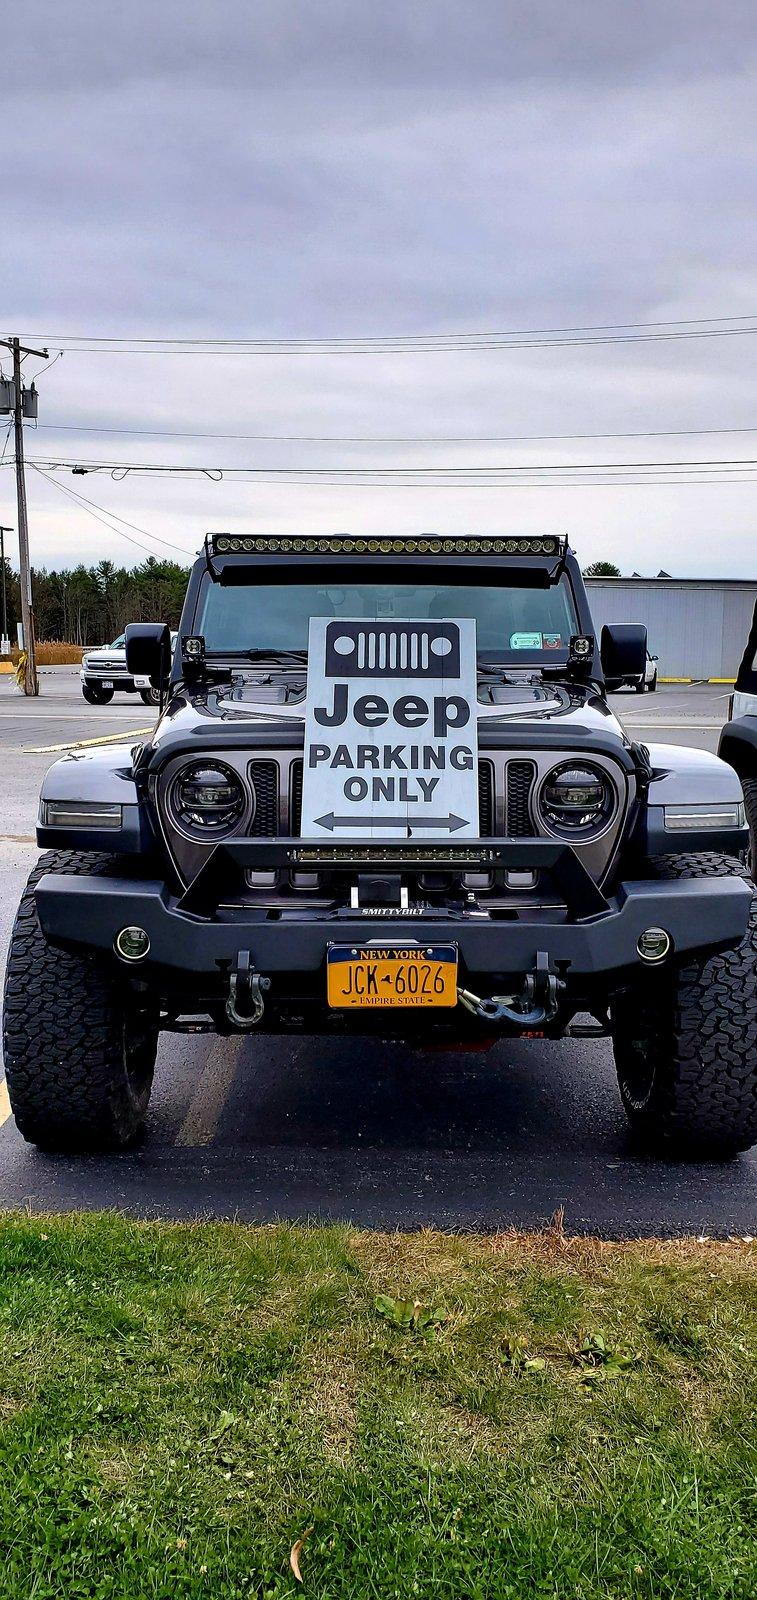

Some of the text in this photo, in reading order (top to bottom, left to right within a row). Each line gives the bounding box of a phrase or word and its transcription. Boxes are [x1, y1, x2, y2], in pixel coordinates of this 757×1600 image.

[313, 683, 471, 738] Jeep
[308, 744, 474, 771] PARKING
[343, 776, 440, 803] ONLY
[359, 950, 426, 960] NEW YORK
[341, 964, 445, 995] JCK 6026
[360, 996, 426, 1005] EMPIRE STATE
